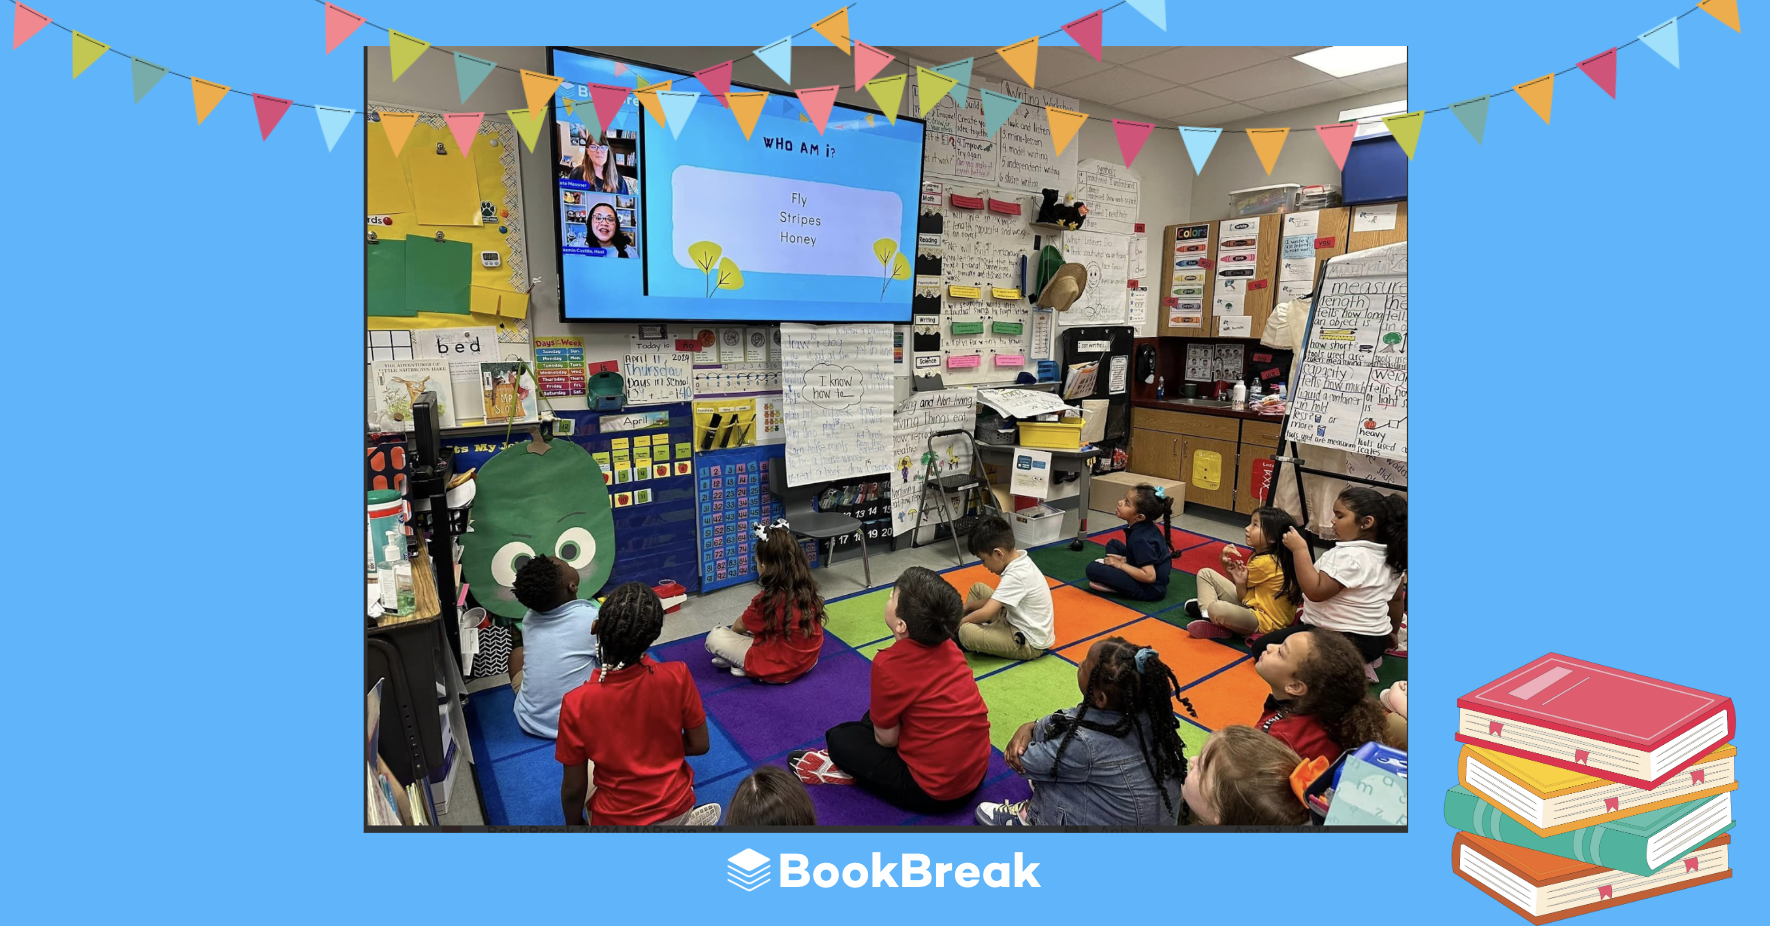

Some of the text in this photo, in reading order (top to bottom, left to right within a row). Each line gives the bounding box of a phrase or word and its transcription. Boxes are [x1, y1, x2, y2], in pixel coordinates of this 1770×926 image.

[1006, 83, 1039, 114] Writing
[958, 114, 977, 126] Create
[1021, 122, 1030, 131] and
[800, 142, 819, 155] AM
[792, 193, 807, 207] Fly
[780, 212, 821, 226] Stripes
[1178, 226, 1207, 239] Colors
[780, 232, 816, 247] Honey
[1321, 295, 1365, 310] length
[1317, 308, 1383, 323] tells how long
[1329, 318, 1358, 328] object
[636, 342, 661, 351] Today
[1310, 339, 1326, 349] how
[625, 354, 647, 364] April
[1308, 350, 1324, 358] tools
[625, 363, 682, 378] Thursday
[1303, 364, 1346, 382] capacity
[627, 378, 650, 388] Days
[819, 374, 852, 387] I know
[1302, 376, 1365, 393] tells how much
[813, 387, 831, 399] how
[1369, 384, 1390, 394] tells
[920, 394, 934, 408] and
[1312, 401, 1329, 413] hold
[1379, 394, 1398, 410] light
[924, 411, 949, 428] Things
[1293, 409, 1314, 420] less?
[623, 415, 648, 428] April
[1291, 421, 1313, 430] more
[1359, 428, 1386, 442] heavy
[474, 444, 496, 452] My
[1357, 447, 1380, 456] scales
[1377, 443, 1396, 451] used
[855, 510, 865, 518] 13
[868, 507, 877, 515] 14
[839, 528, 892, 544] 17 19 20
